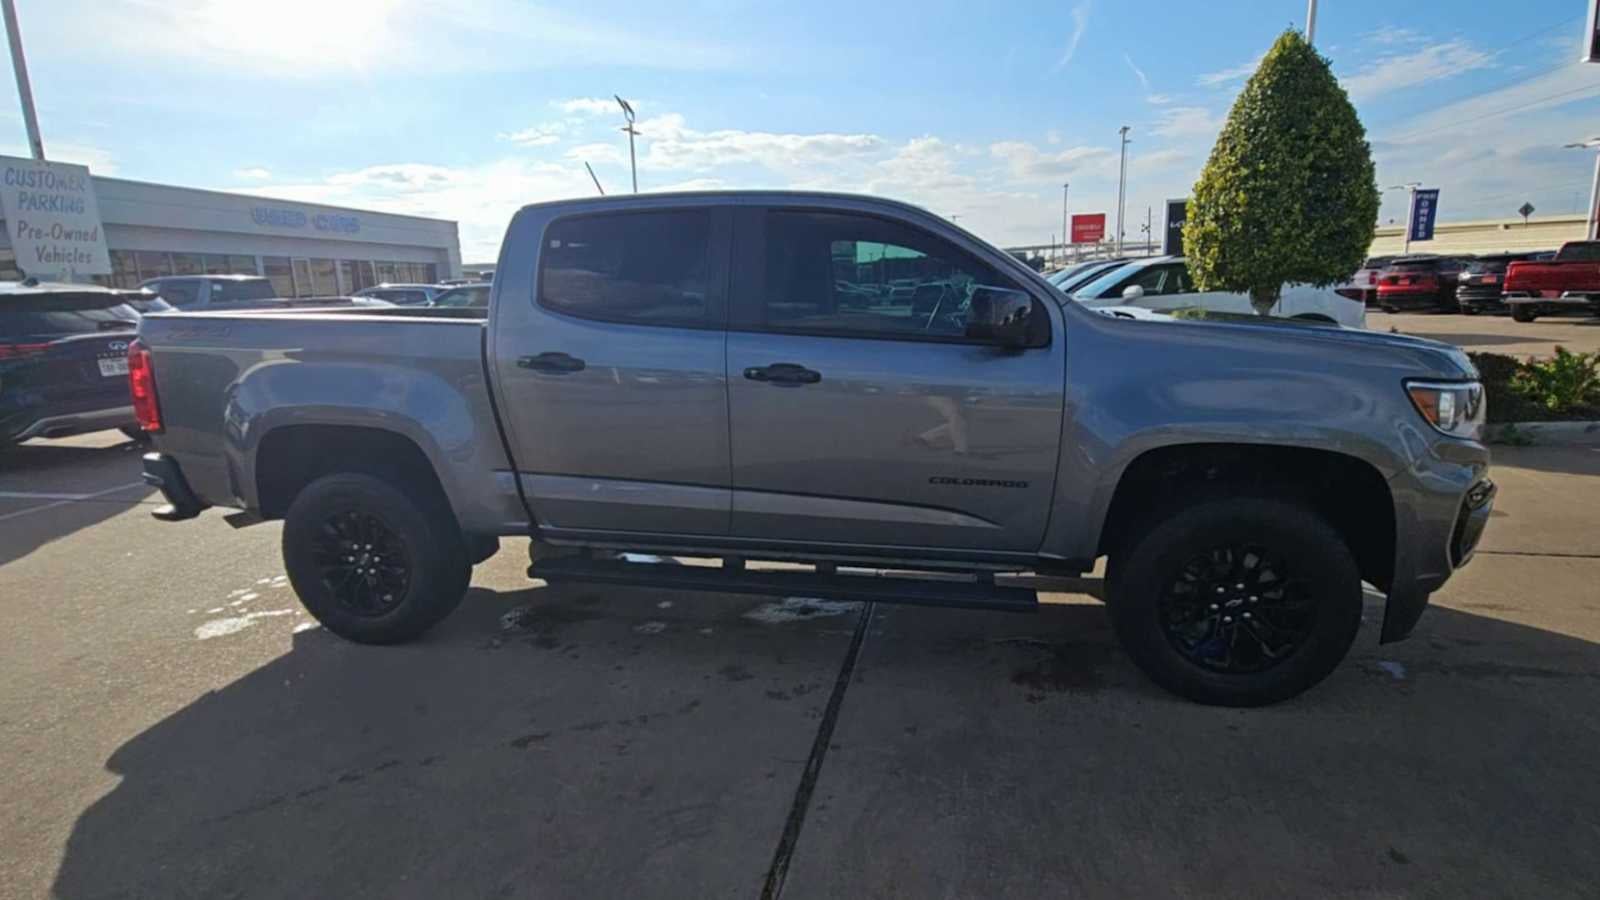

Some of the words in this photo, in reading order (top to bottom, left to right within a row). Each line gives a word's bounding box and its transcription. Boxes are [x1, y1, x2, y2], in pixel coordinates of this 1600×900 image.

[4, 167, 86, 192] CUSTOMER
[17, 191, 85, 214] PARKING
[17, 220, 98, 242] Pre-Owned
[35, 245, 92, 264] Vehicles
[927, 476, 1029, 488] COLORADO
